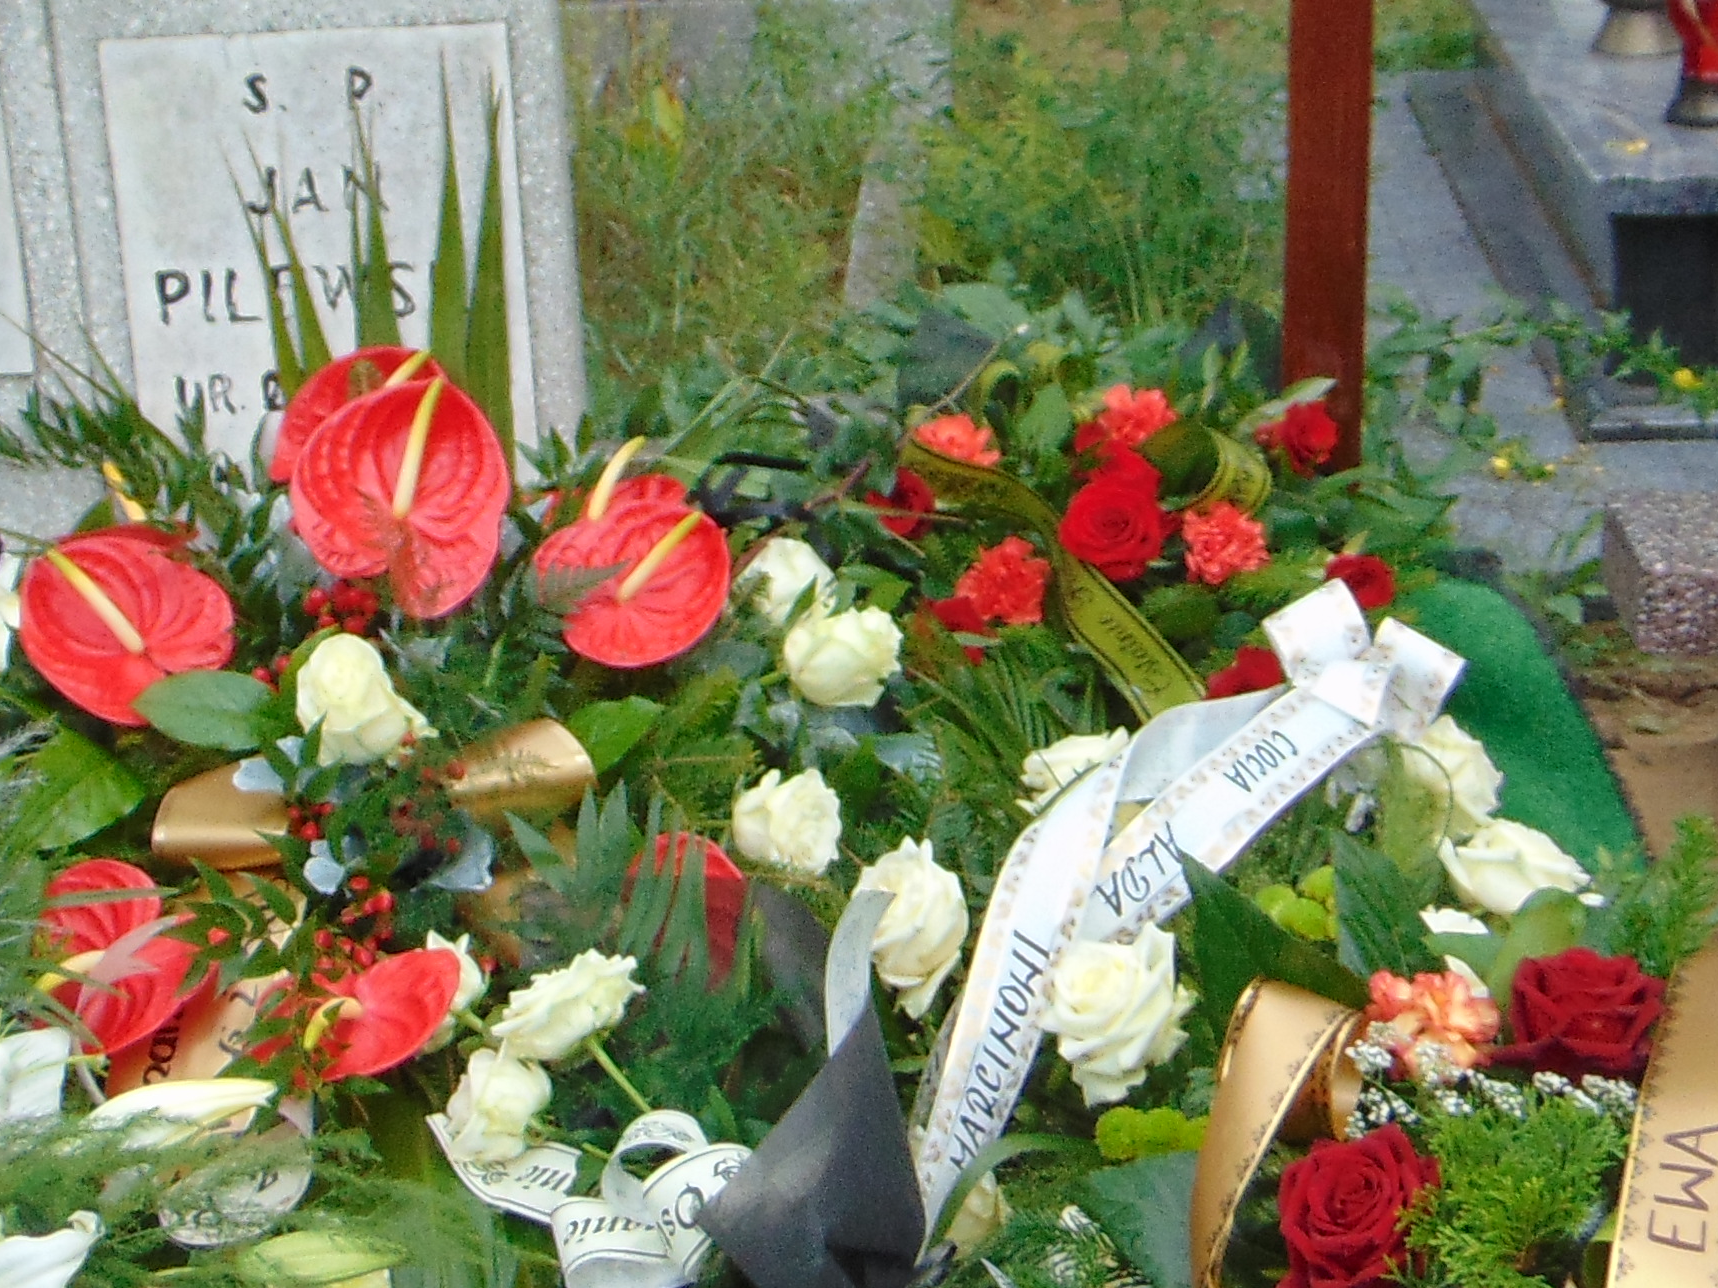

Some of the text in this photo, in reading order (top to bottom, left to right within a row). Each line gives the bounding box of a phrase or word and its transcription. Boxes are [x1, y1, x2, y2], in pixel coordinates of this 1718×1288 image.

[243, 165, 390, 215] JAN
[1094, 729, 1299, 918] CIOCIA ALDA
